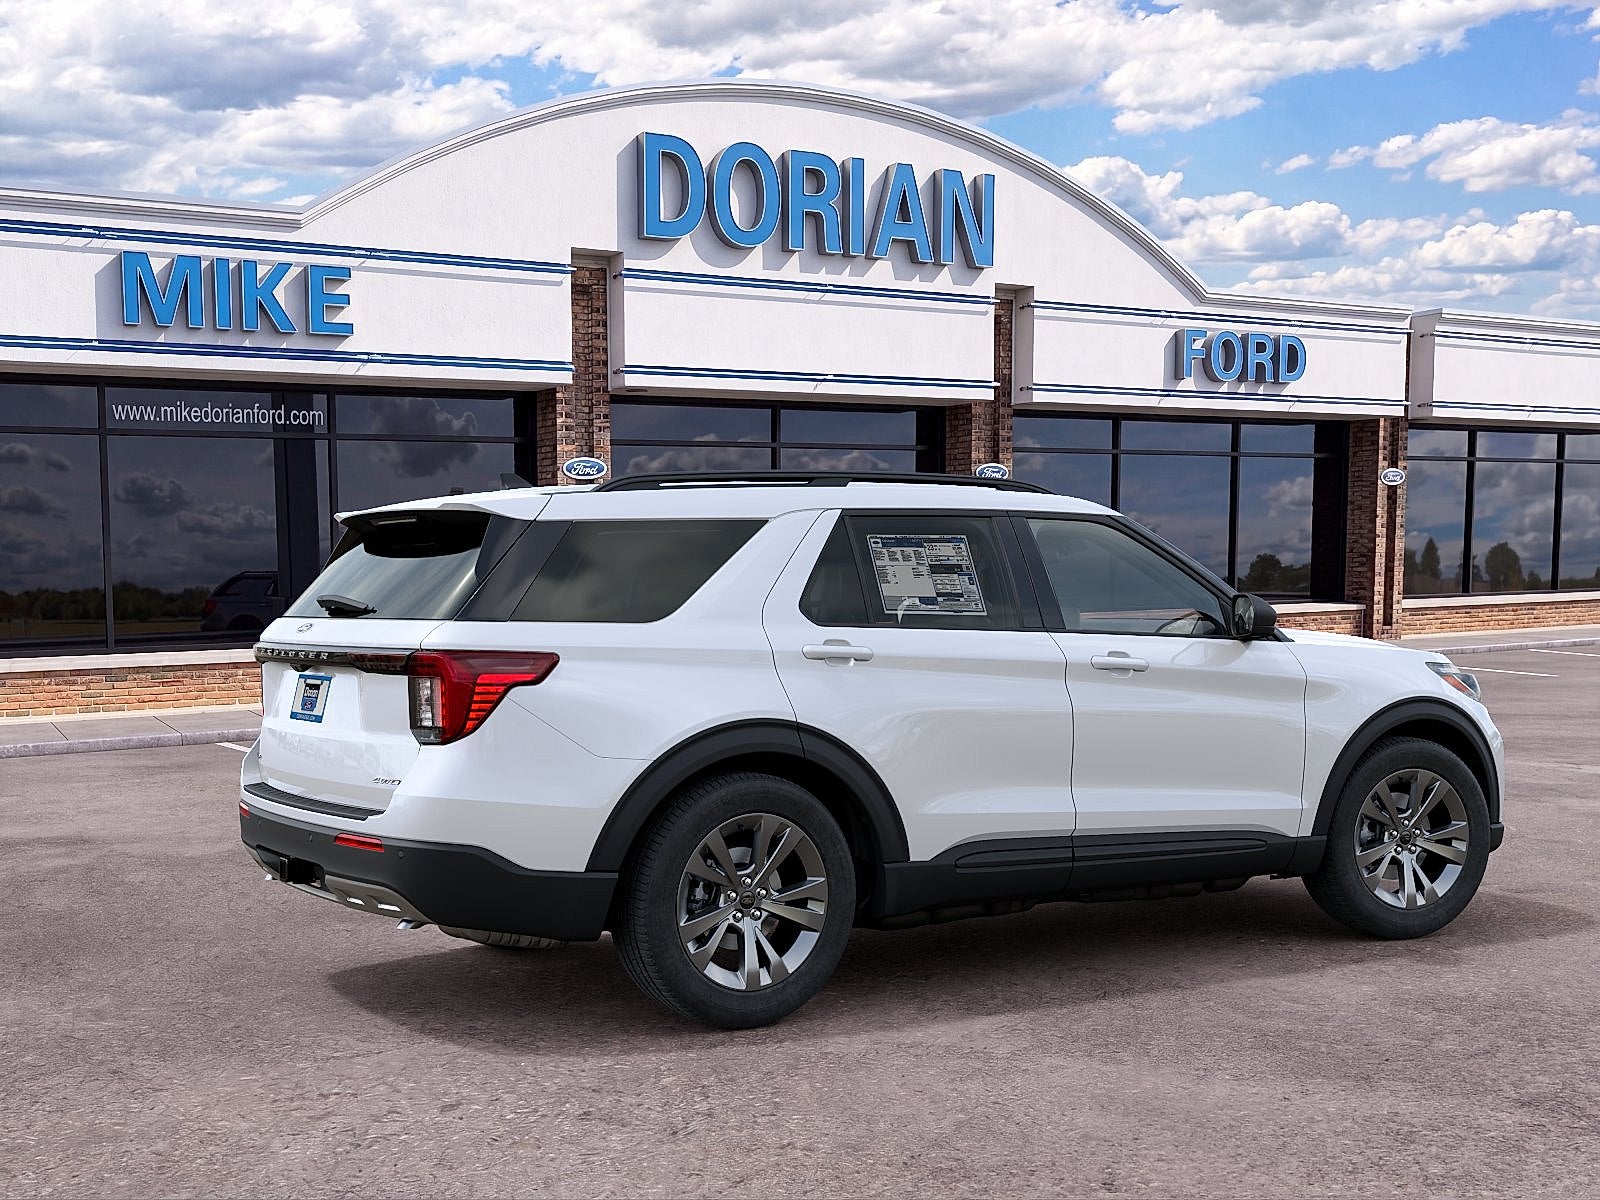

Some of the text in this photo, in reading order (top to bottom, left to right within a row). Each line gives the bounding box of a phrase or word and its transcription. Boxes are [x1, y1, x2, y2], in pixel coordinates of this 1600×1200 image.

[638, 131, 996, 269] DORIAN
[120, 250, 355, 337] MIKE
[1175, 328, 1307, 384] FORD
[111, 401, 325, 426] www.mikedorianford.com
[571, 463, 599, 475] Ford
[260, 648, 329, 660] EXPLORER
